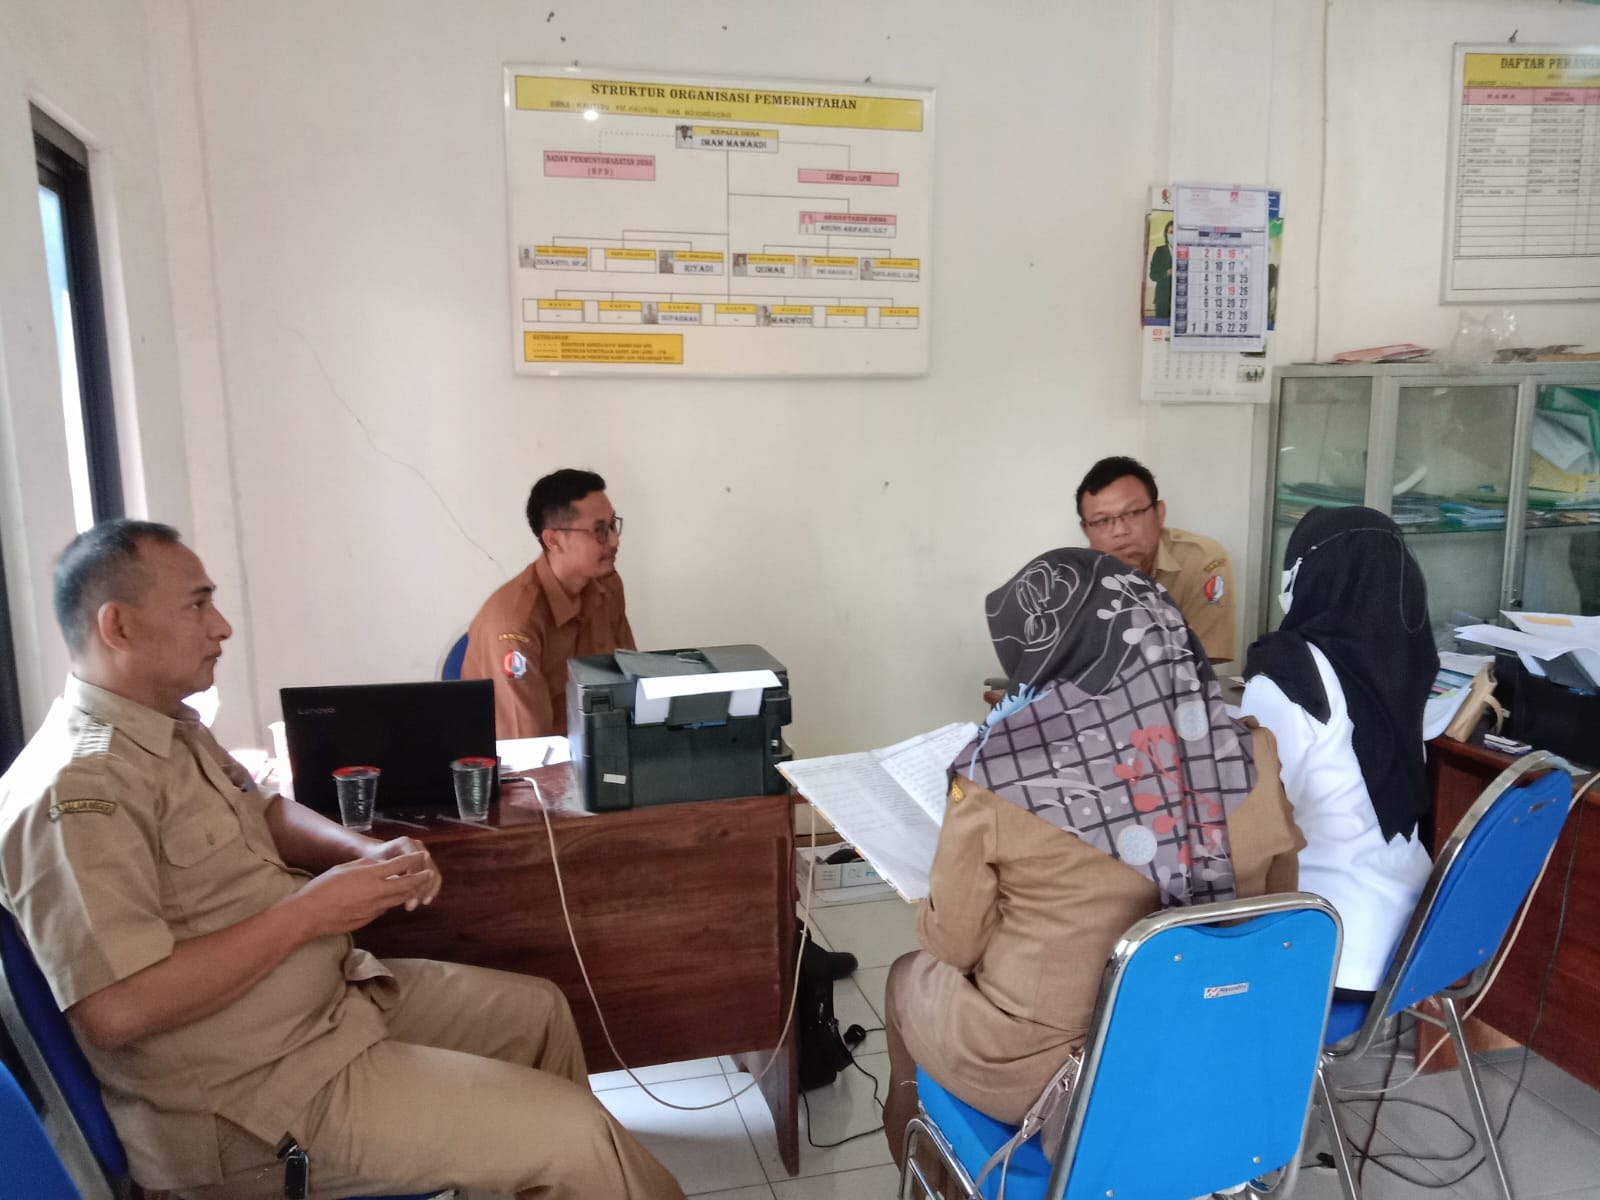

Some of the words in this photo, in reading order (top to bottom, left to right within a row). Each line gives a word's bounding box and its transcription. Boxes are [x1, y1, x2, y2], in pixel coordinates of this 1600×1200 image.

[1500, 58, 1545, 69] DAFTAR
[591, 83, 666, 99] STRUKTUR
[669, 88, 750, 105] ORGANISASI
[754, 94, 857, 110] PEMERINTAHAN
[726, 139, 767, 149] MAWARDI
[683, 264, 714, 273] RIYADI
[1228, 261, 1235, 271] 17
[1216, 274, 1222, 283] 11
[1240, 274, 1248, 284] 25
[1215, 286, 1222, 296] 12
[1240, 286, 1248, 296] 26
[1215, 298, 1223, 308] 13
[1240, 298, 1248, 308] 27
[1215, 310, 1223, 320] 14
[1228, 310, 1235, 320] 21
[1240, 310, 1248, 320] 28
[1215, 323, 1223, 333] 15
[1227, 323, 1235, 333] 22
[1239, 323, 1248, 333] 29
